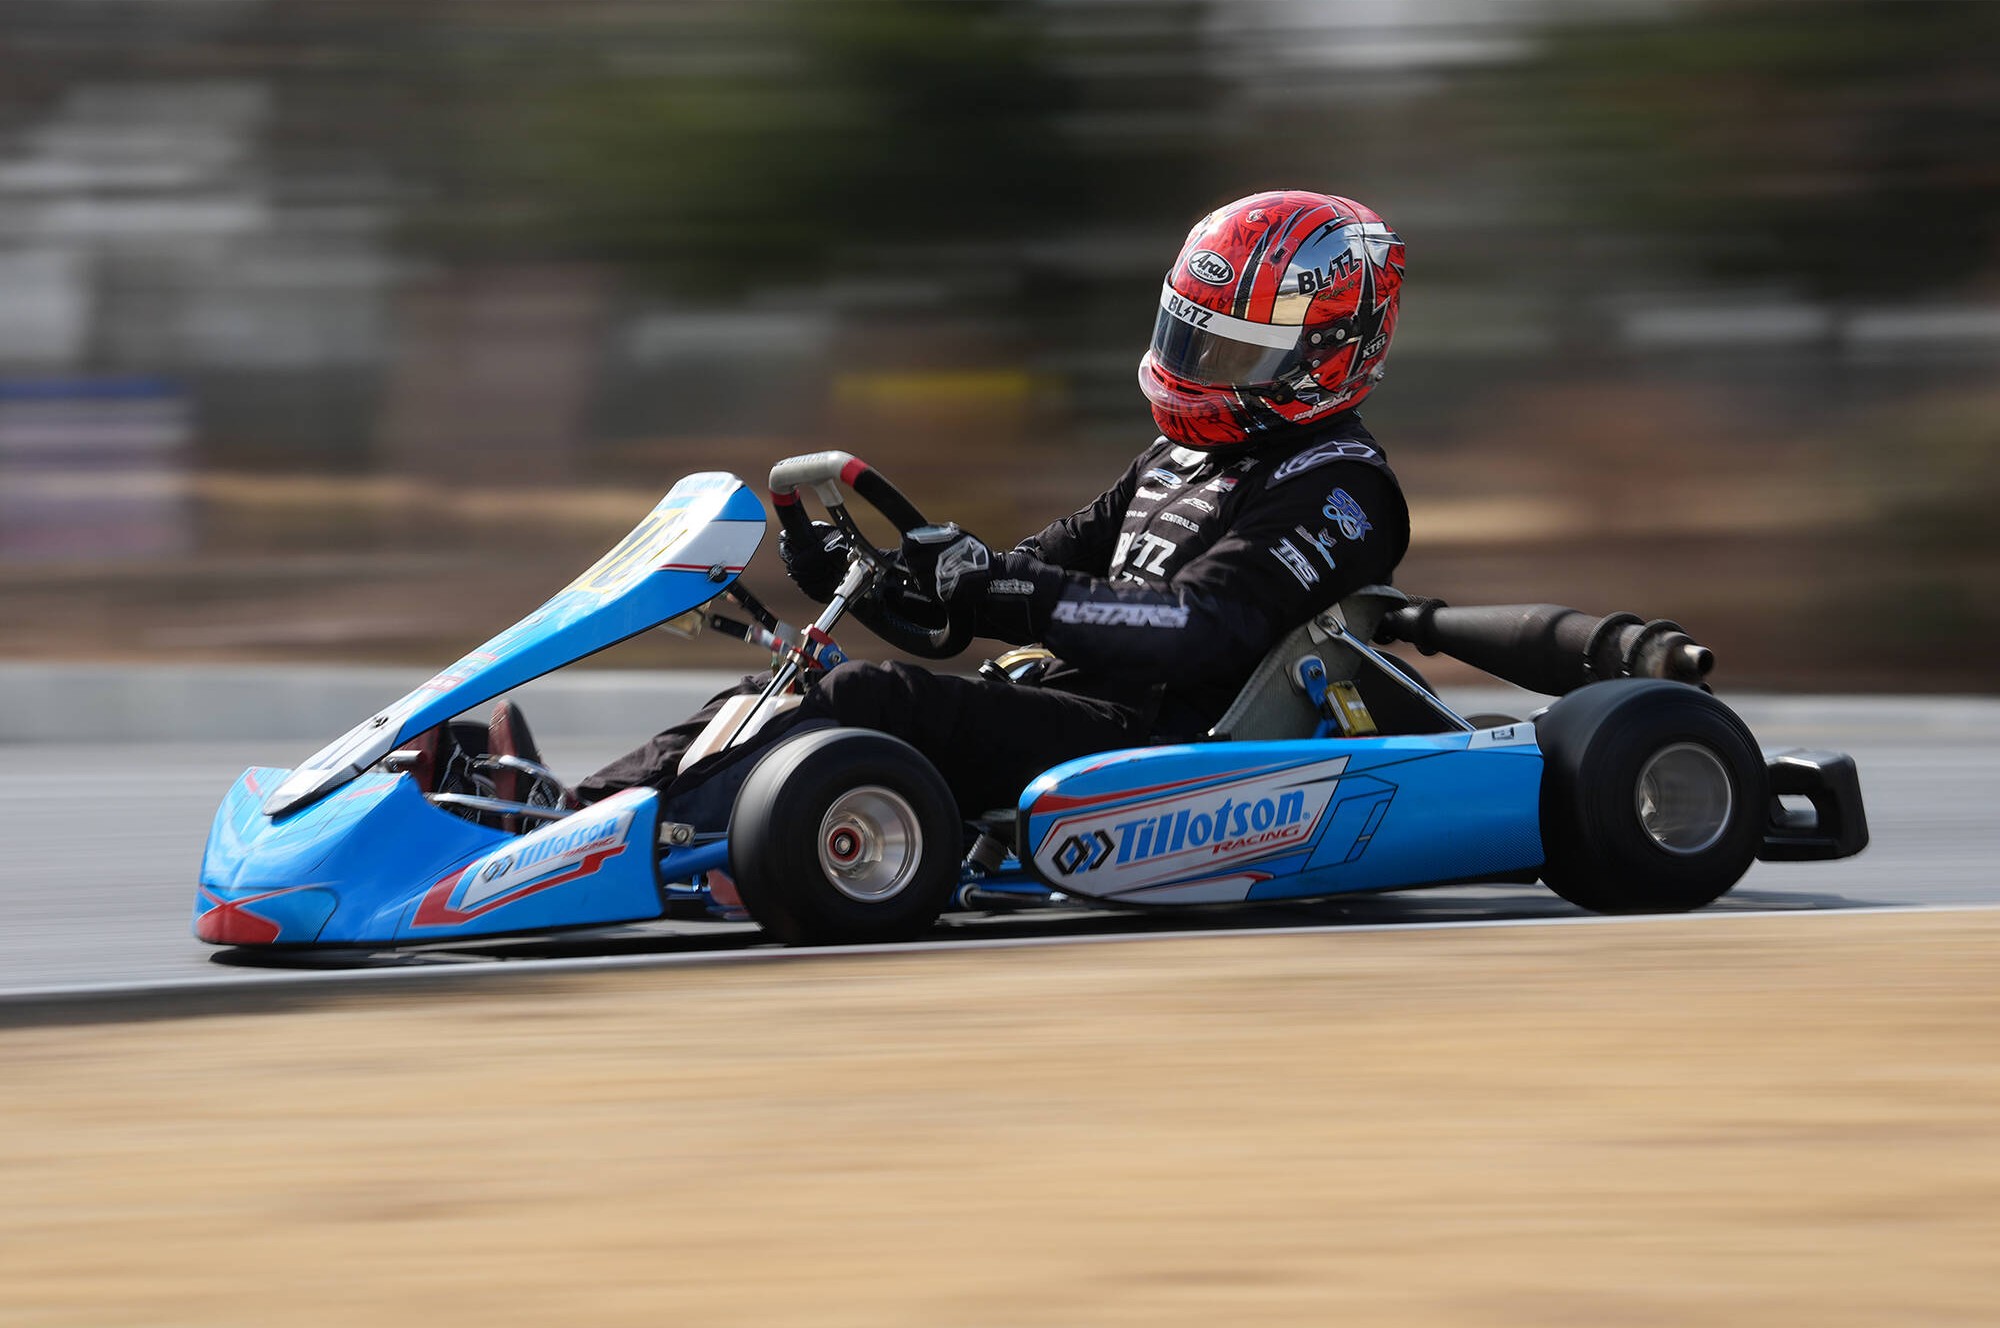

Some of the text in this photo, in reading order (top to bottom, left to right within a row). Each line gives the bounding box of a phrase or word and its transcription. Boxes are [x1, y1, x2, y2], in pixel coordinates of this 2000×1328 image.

[1190, 253, 1230, 279] Arai
[1297, 247, 1360, 295] BLITZ
[1168, 294, 1213, 328] BLITZ
[514, 817, 620, 870] Tillotson
[1114, 790, 1304, 865] Tillotson
[1212, 824, 1301, 855] RACING
